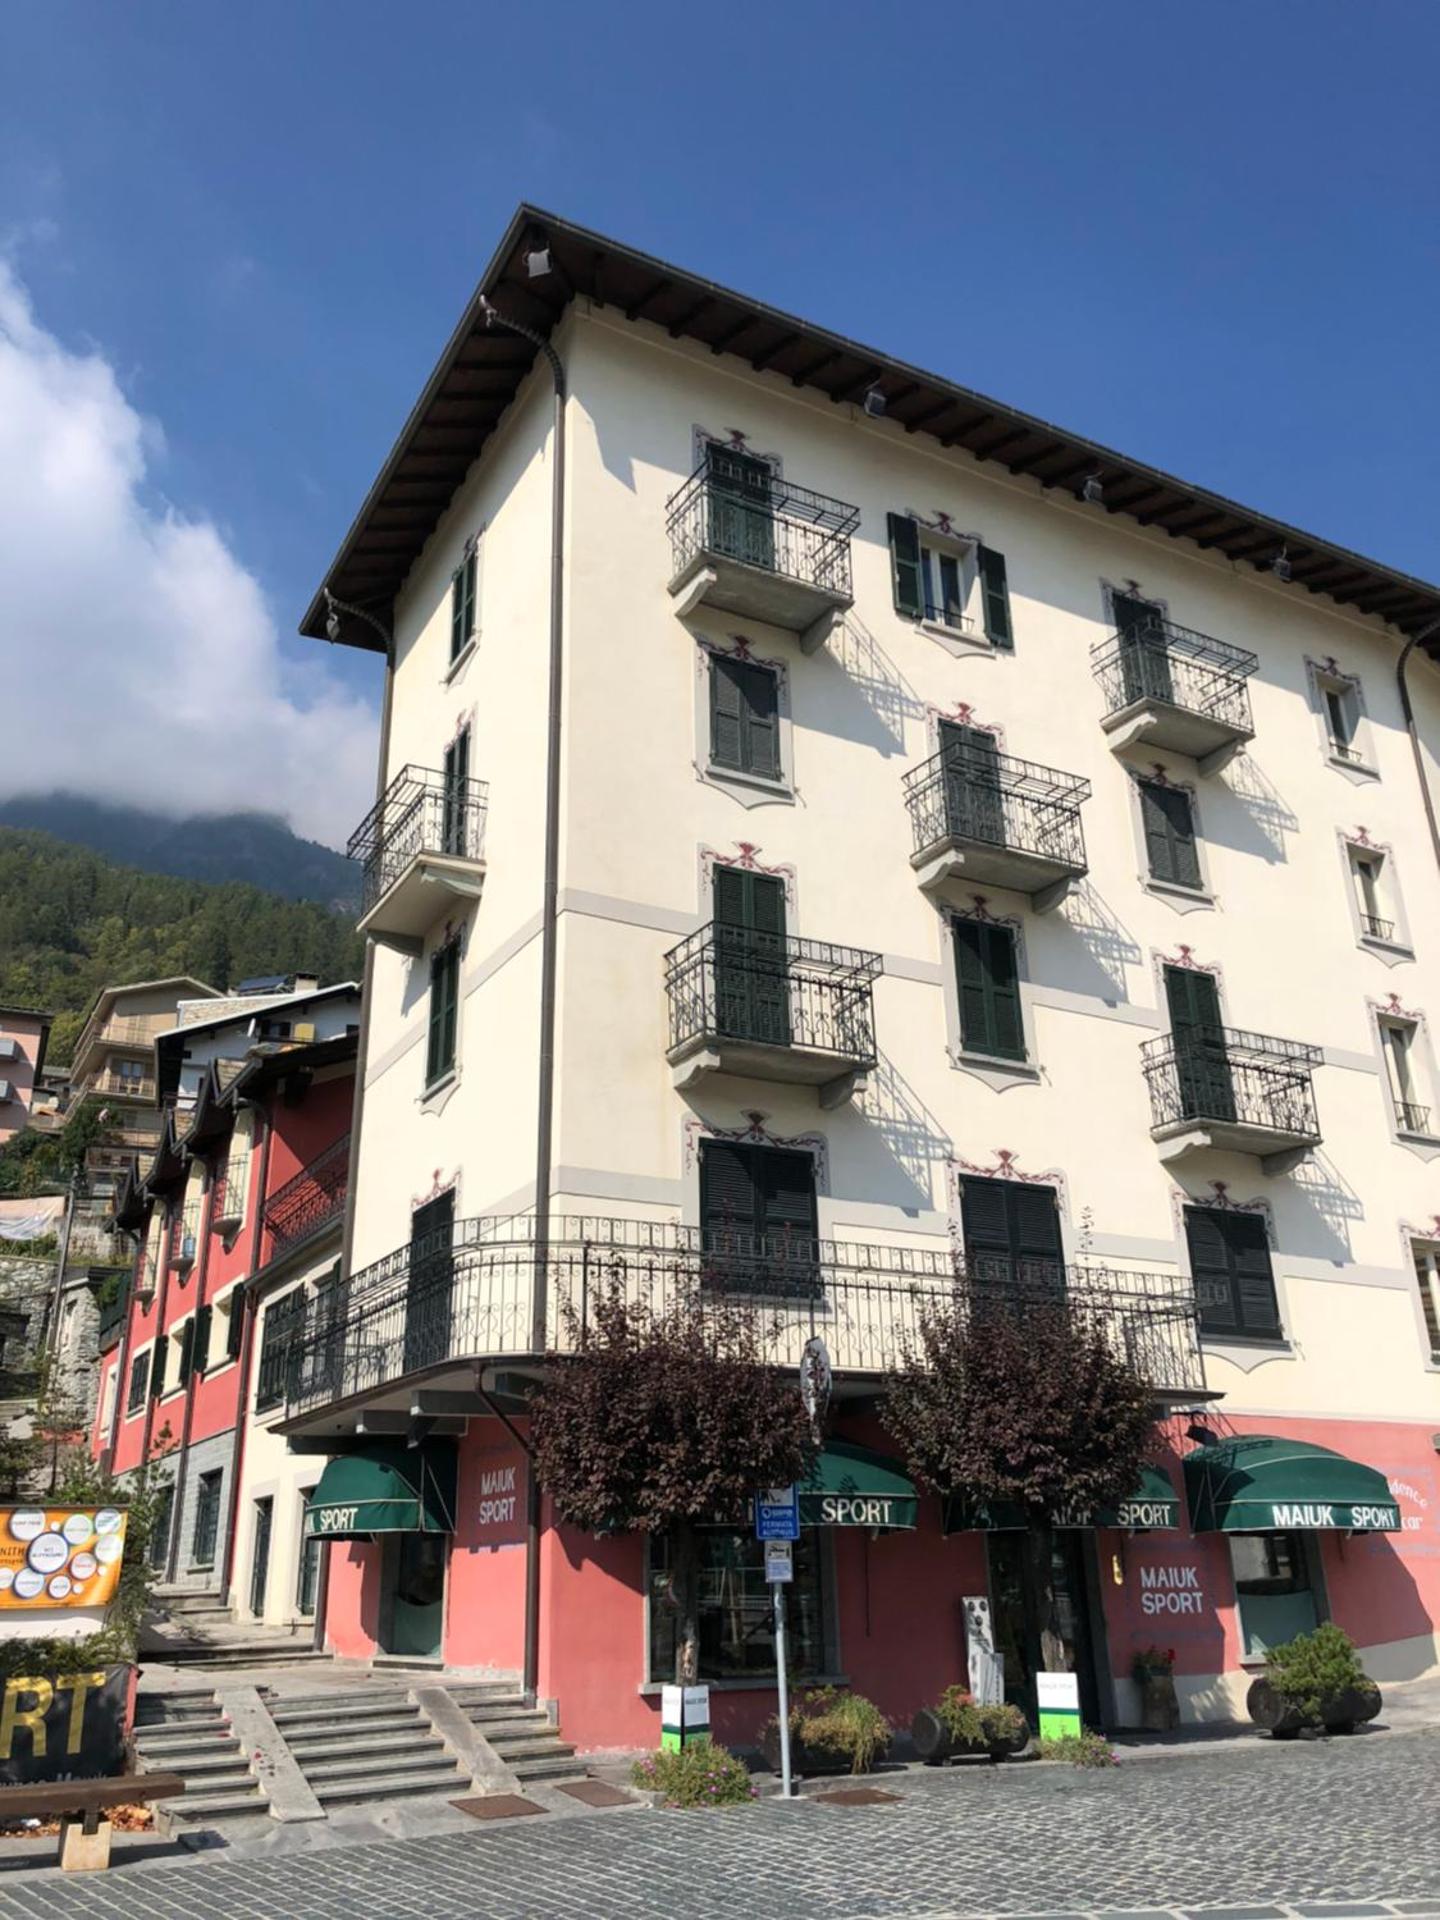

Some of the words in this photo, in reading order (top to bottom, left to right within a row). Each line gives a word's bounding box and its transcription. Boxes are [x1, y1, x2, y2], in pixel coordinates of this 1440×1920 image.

[481, 1467, 516, 1495] MAIUK
[319, 1508, 359, 1531] SPORT
[480, 1497, 516, 1524] SPORT
[821, 1498, 892, 1523] SPORT
[1117, 1503, 1171, 1526] SPORT
[1272, 1505, 1336, 1527] MAIUK
[1351, 1506, 1396, 1527] SPORT
[1401, 1516, 1424, 1531] car
[1140, 1567, 1199, 1589] MAIUK
[1141, 1592, 1204, 1614] SPORT
